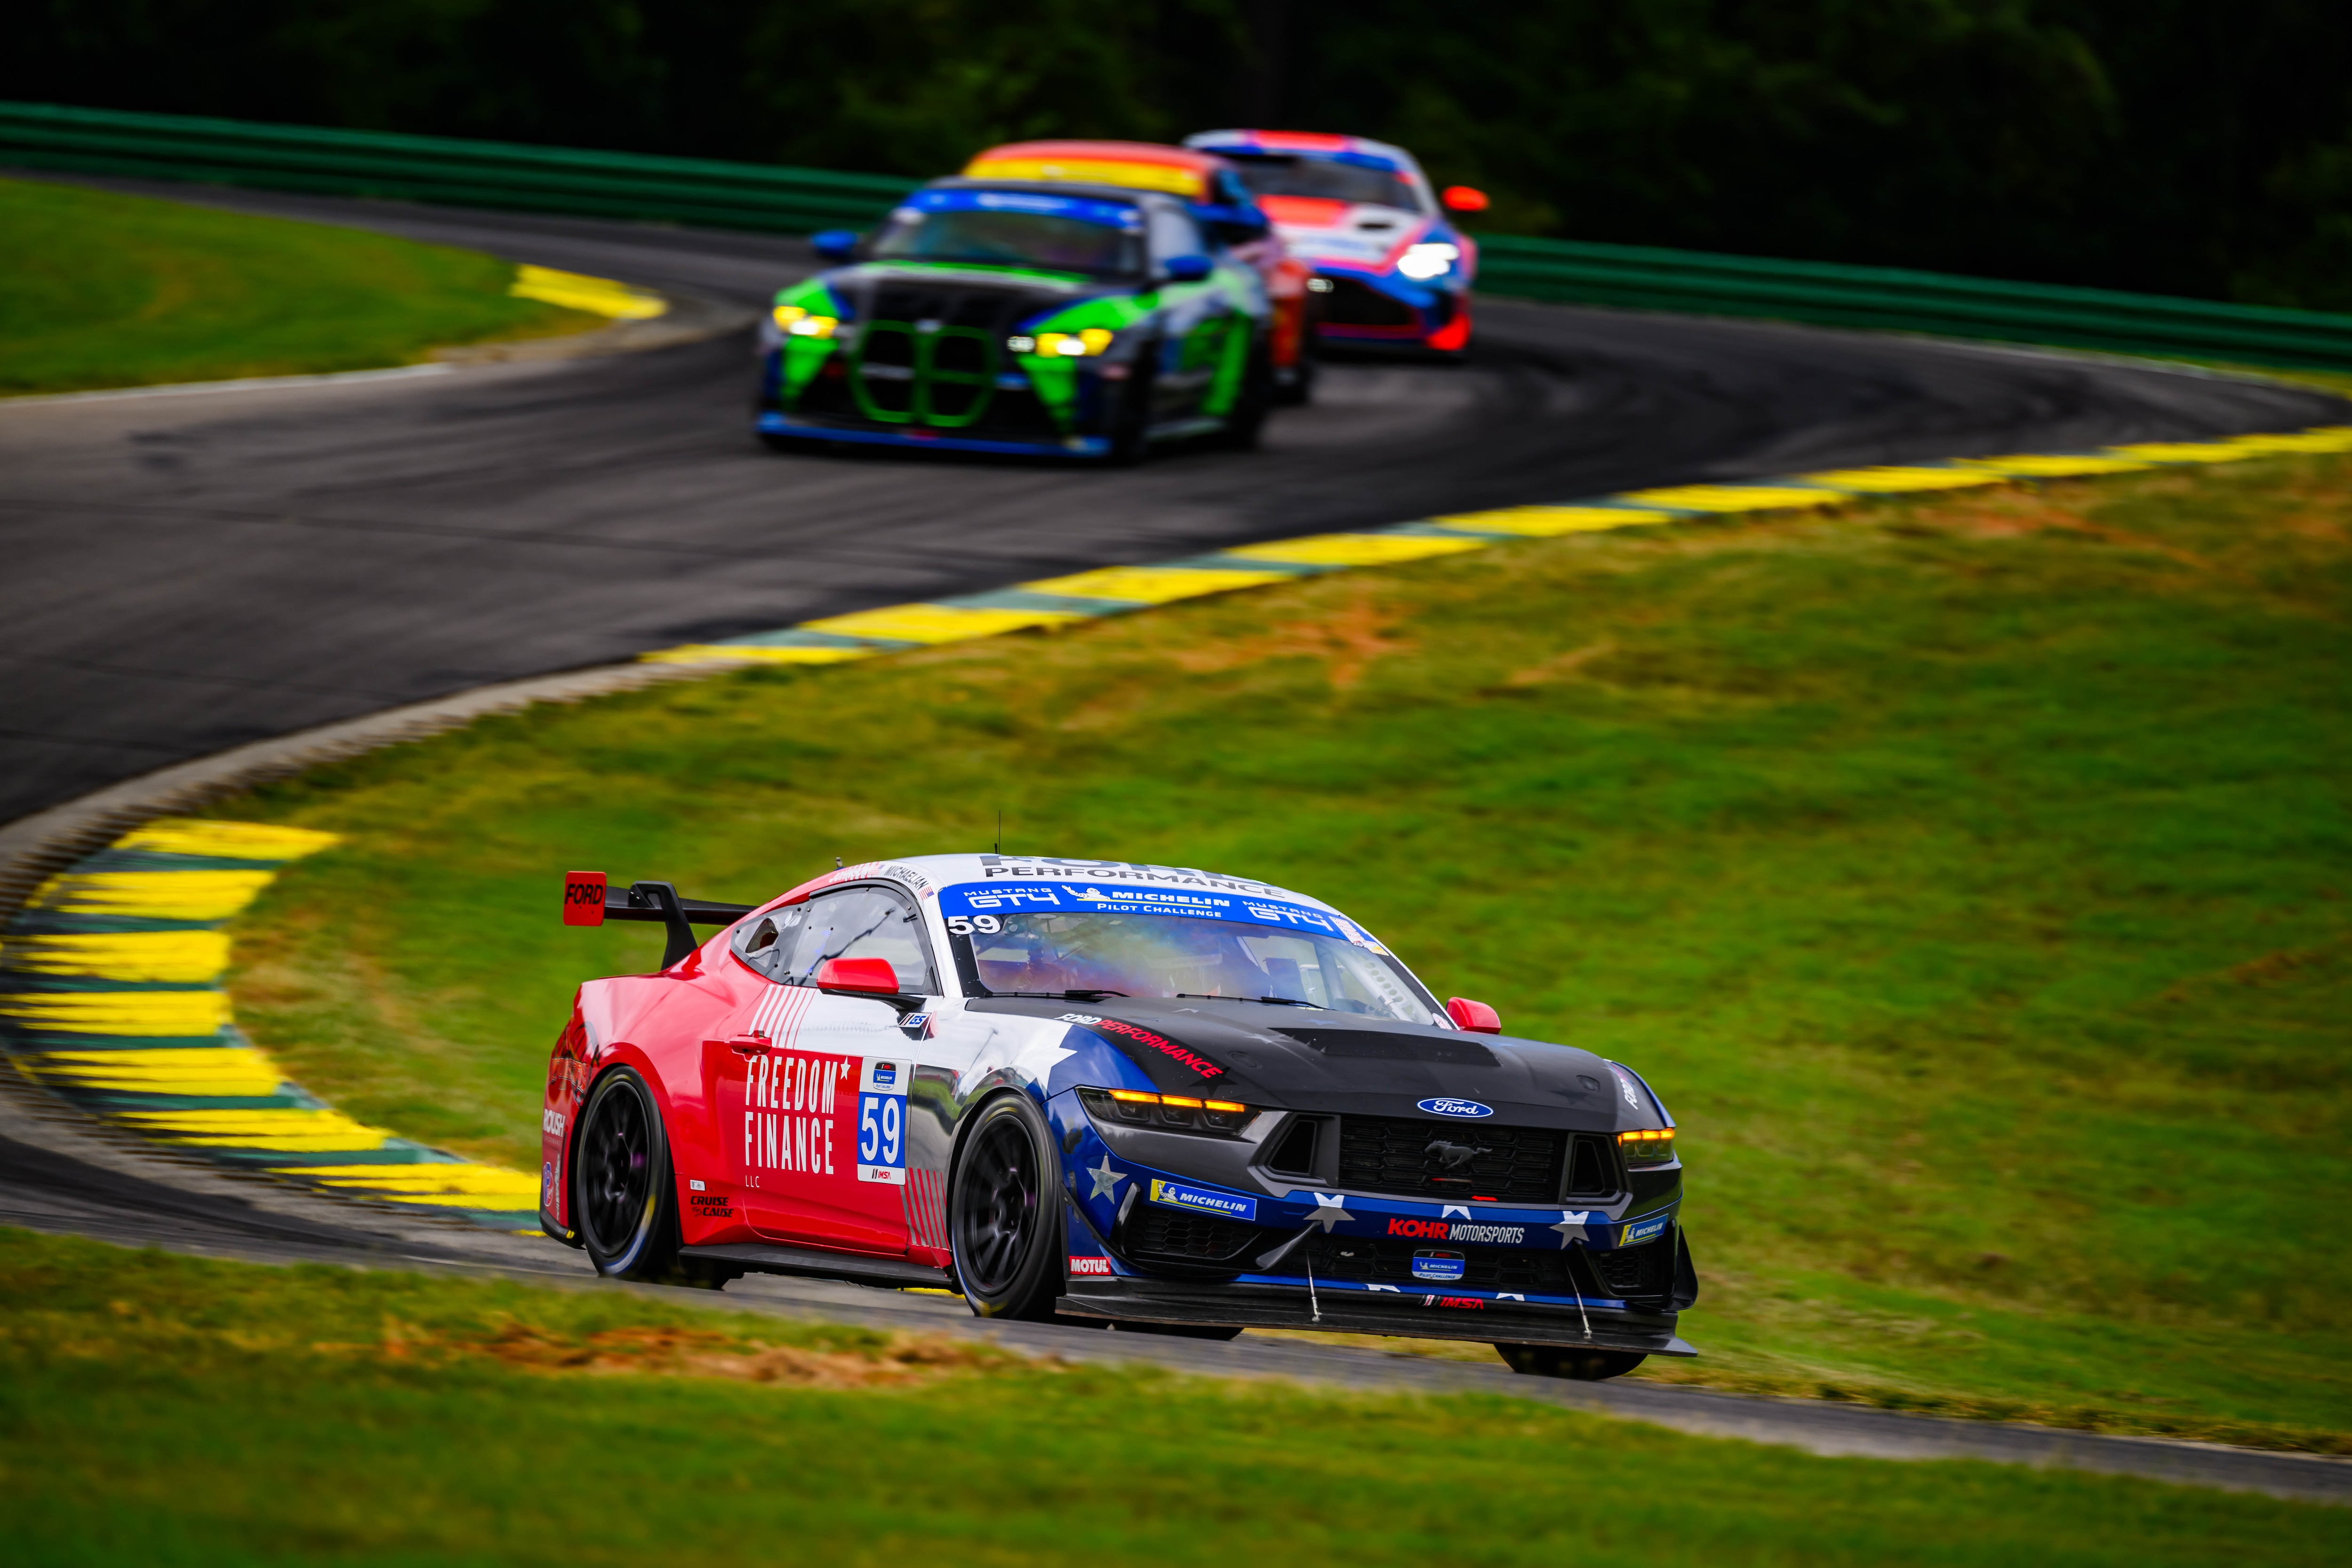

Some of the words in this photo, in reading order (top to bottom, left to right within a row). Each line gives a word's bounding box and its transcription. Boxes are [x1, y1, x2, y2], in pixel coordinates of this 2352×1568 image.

[884, 866, 929, 891] MICHAELIAN
[985, 867, 1285, 899] PERFORMANCE
[564, 883, 604, 905] FORD
[963, 888, 1052, 897] MUSTANG
[968, 893, 1061, 909] GT4
[1112, 891, 1230, 907] MICHELIN
[1097, 903, 1138, 912] PILOT
[1143, 905, 1222, 918] CHALLENGE
[1242, 900, 1323, 919] MUSTANG
[948, 915, 1001, 935] 59
[1248, 907, 1334, 931] GT4
[909, 1015, 927, 1025] GS
[1054, 1013, 1102, 1025] FORD
[1091, 1019, 1224, 1078] PERFORMANCE
[745, 1054, 838, 1114] FREEDOM
[1433, 1099, 1479, 1114] Ford
[542, 1108, 566, 1138] ROUSH
[861, 1097, 900, 1164] 59
[745, 1111, 834, 1175] FINANCE
[745, 1175, 760, 1188] LLC
[878, 1171, 891, 1180] IMSA
[690, 1196, 729, 1206] CRUISE
[1179, 1192, 1247, 1212] MICHELIN
[702, 1207, 734, 1218] CAUSE
[1387, 1218, 1449, 1240] KOHR
[1449, 1224, 1525, 1243] MOTORSPORTS
[1635, 1222, 1664, 1237] MICHELIN
[1071, 1258, 1110, 1273] MOTUL
[1439, 1297, 1484, 1309] IMSA
